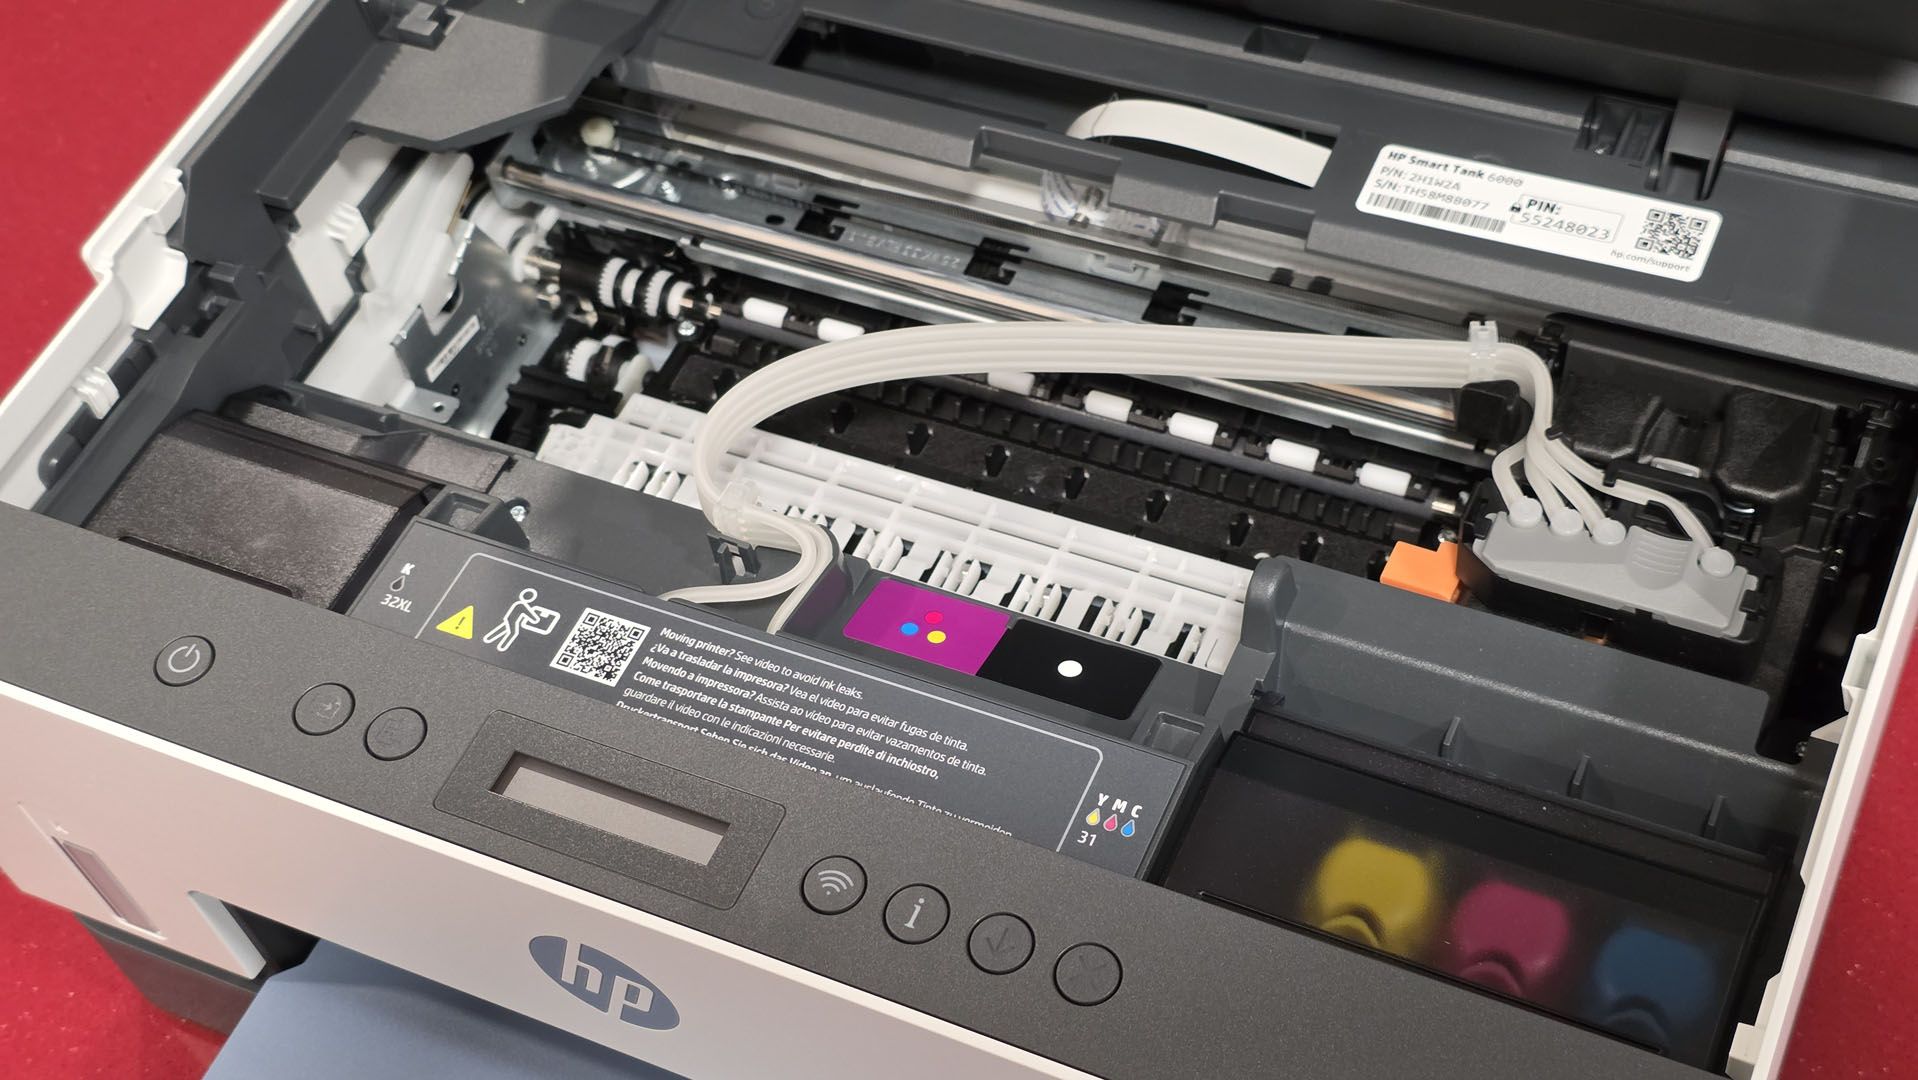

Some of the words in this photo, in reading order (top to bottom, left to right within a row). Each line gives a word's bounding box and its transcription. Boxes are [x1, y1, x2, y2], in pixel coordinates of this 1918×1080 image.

[1380, 165, 1407, 181] P/N:
[1387, 150, 1407, 163] HP
[1408, 154, 1450, 173] Smart
[1452, 163, 1485, 180] Tank
[1487, 173, 1524, 188] 6000
[1373, 178, 1402, 195] S/N:
[1525, 198, 1562, 216] PIN:
[1610, 248, 1691, 273] hp.com/support
[400, 562, 416, 576] K
[380, 593, 413, 613] 32XL
[660, 628, 697, 648] Moving
[695, 641, 737, 658] printer?
[734, 651, 754, 665] See
[755, 659, 781, 673] video
[781, 666, 793, 677] to
[793, 672, 822, 686] avoid
[820, 679, 837, 691] ink
[836, 683, 863, 700] leaks.
[650, 643, 671, 655] ¿Va
[670, 650, 678, 658] a
[678, 651, 724, 672] trasladar
[723, 664, 734, 676] la
[733, 668, 791, 693] impresora?
[790, 686, 809, 700] Vea
[809, 694, 821, 704] el
[846, 706, 870, 720] para
[871, 714, 900, 729] evitar
[900, 721, 929, 738] fugas
[929, 732, 943, 743] de
[944, 736, 968, 752] tinta.
[623, 688, 668, 708] guardare
[667, 700, 676, 710] il
[676, 704, 702, 719] video
[702, 713, 721, 725] con
[721, 717, 732, 729] le
[731, 721, 784, 745] indicazioni
[782, 740, 835, 764] necessarie.
[634, 671, 662, 688] Come
[662, 681, 718, 706] trasportare
[718, 698, 729, 710] la
[728, 704, 783, 727] stampante
[783, 720, 803, 733] Per
[802, 728, 838, 745] evitare
[837, 739, 875, 758] perdite
[875, 751, 888, 761] di
[886, 753, 939, 780] inchiostro,
[642, 656, 688, 678] Movendo
[687, 673, 696, 681] a
[695, 673, 757, 700] impressora?
[755, 693, 791, 712] Assista
[790, 706, 804, 716] ao
[831, 720, 856, 733] para
[856, 728, 886, 742] evitar
[886, 736, 947, 763] vazamentos
[947, 756, 961, 768] de
[962, 760, 987, 776] tinta.
[1097, 793, 1110, 807] Y
[1111, 798, 1128, 814] M
[1131, 804, 1143, 818] C
[1077, 830, 1097, 847] 31
[560, 937, 655, 1021] hp
